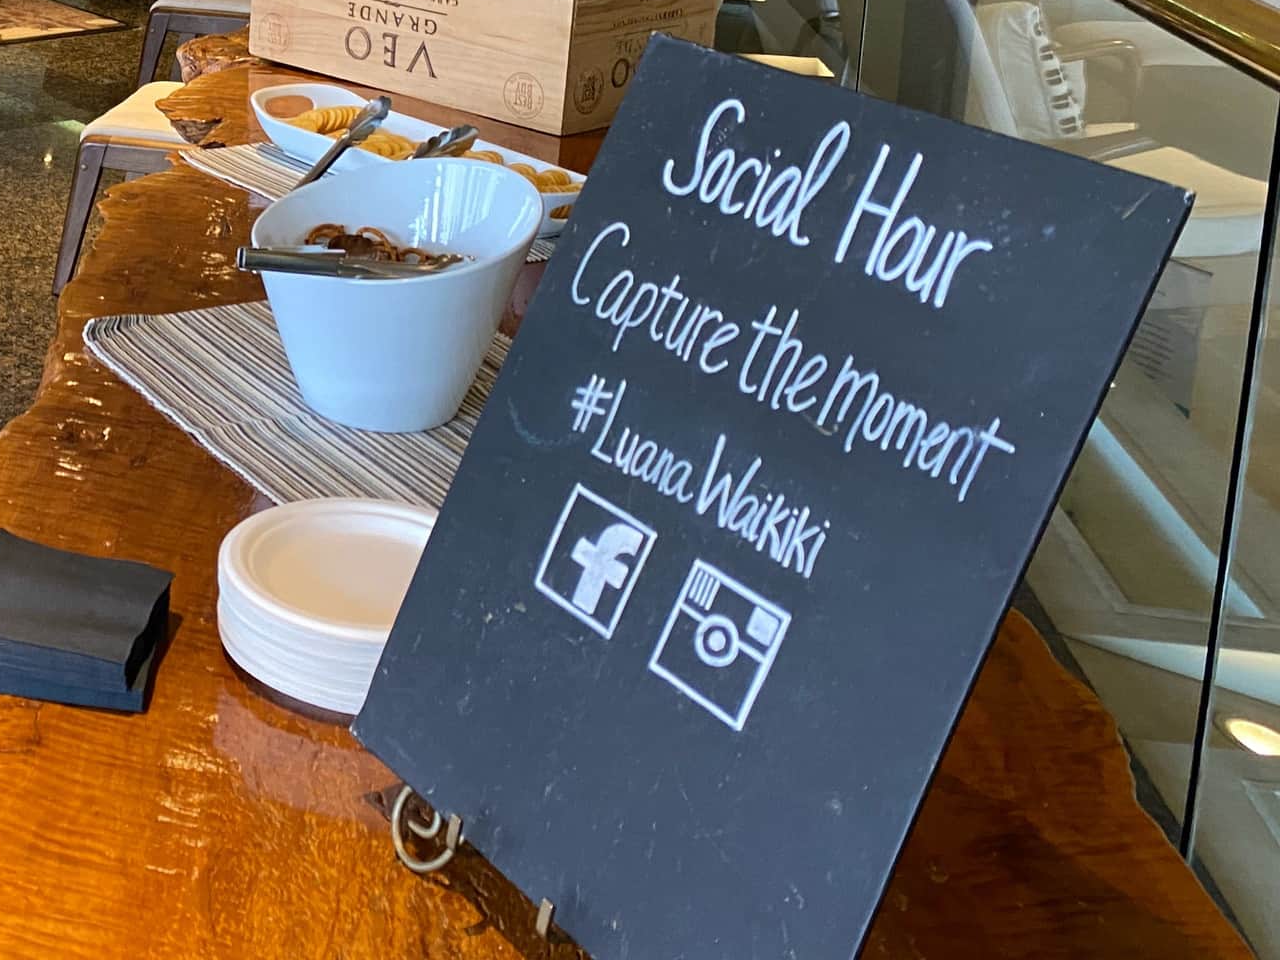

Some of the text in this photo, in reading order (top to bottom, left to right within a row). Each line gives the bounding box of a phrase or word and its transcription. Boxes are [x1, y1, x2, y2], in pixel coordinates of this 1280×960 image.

[344, 25, 438, 79] VEO
[348, 1, 438, 36] GRANDE
[663, 98, 993, 308] Social Hour
[571, 222, 740, 373] Capture
[738, 304, 828, 413] the
